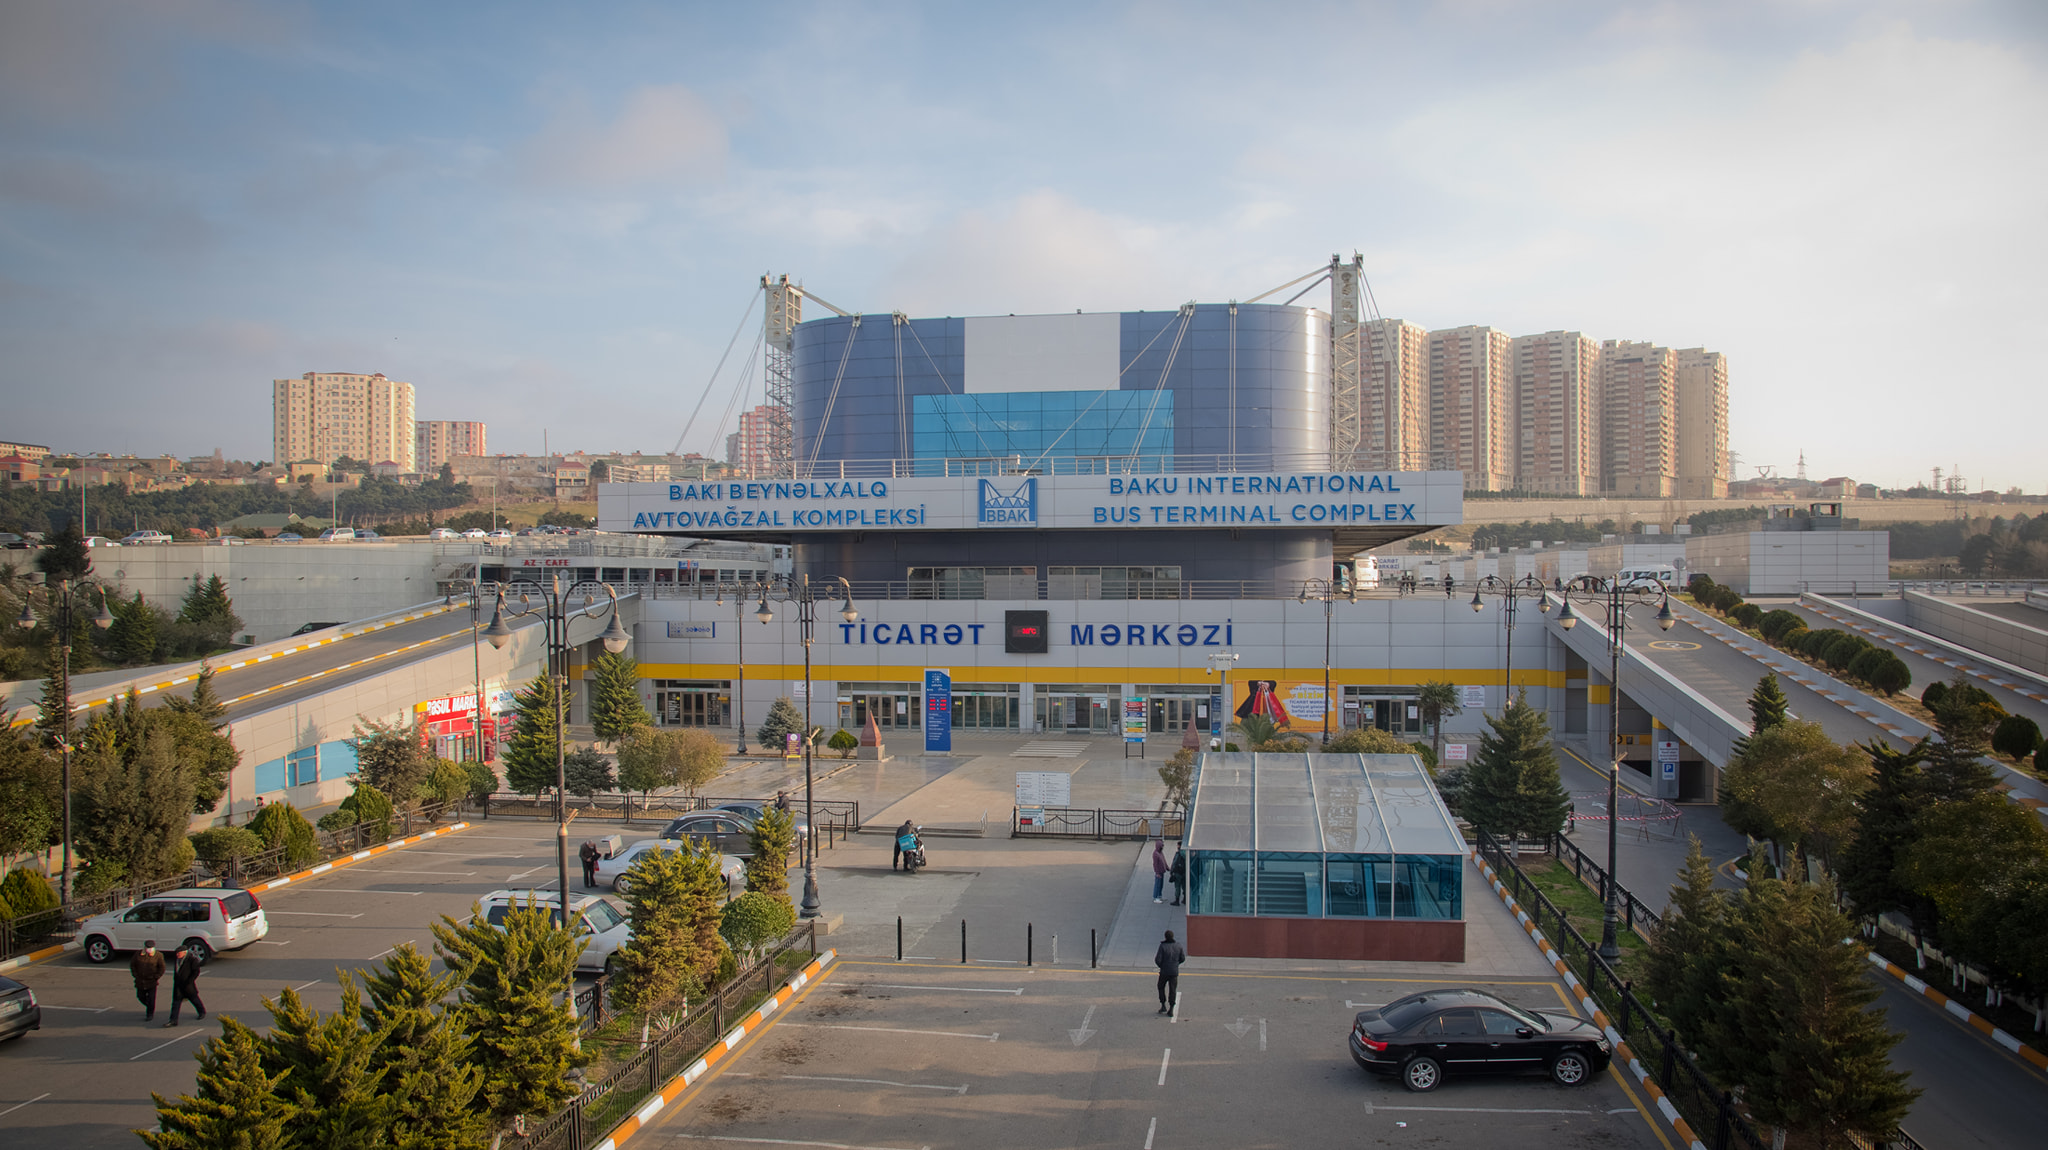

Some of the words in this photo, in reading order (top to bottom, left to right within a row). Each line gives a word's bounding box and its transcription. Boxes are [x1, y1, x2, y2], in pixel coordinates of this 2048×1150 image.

[669, 483, 722, 501] BAKI
[729, 481, 888, 500] BEYNƏLXALQ
[1109, 478, 1179, 495] BAKU
[1188, 474, 1401, 494] INTERNATIONAL
[632, 505, 785, 528] AVTOVAĞZAL
[792, 504, 926, 527] KOMPLEKSİ
[986, 509, 1028, 522] BBAK
[1093, 506, 1141, 523] BUS
[1150, 505, 1281, 523] TERMINAL
[1291, 503, 1416, 522] COMPLEX
[545, 559, 569, 567] CAFE
[838, 618, 985, 645] TİCARƏT
[1071, 618, 1233, 646] MƏRKƏZİ
[1665, 764, 1672, 772] P
